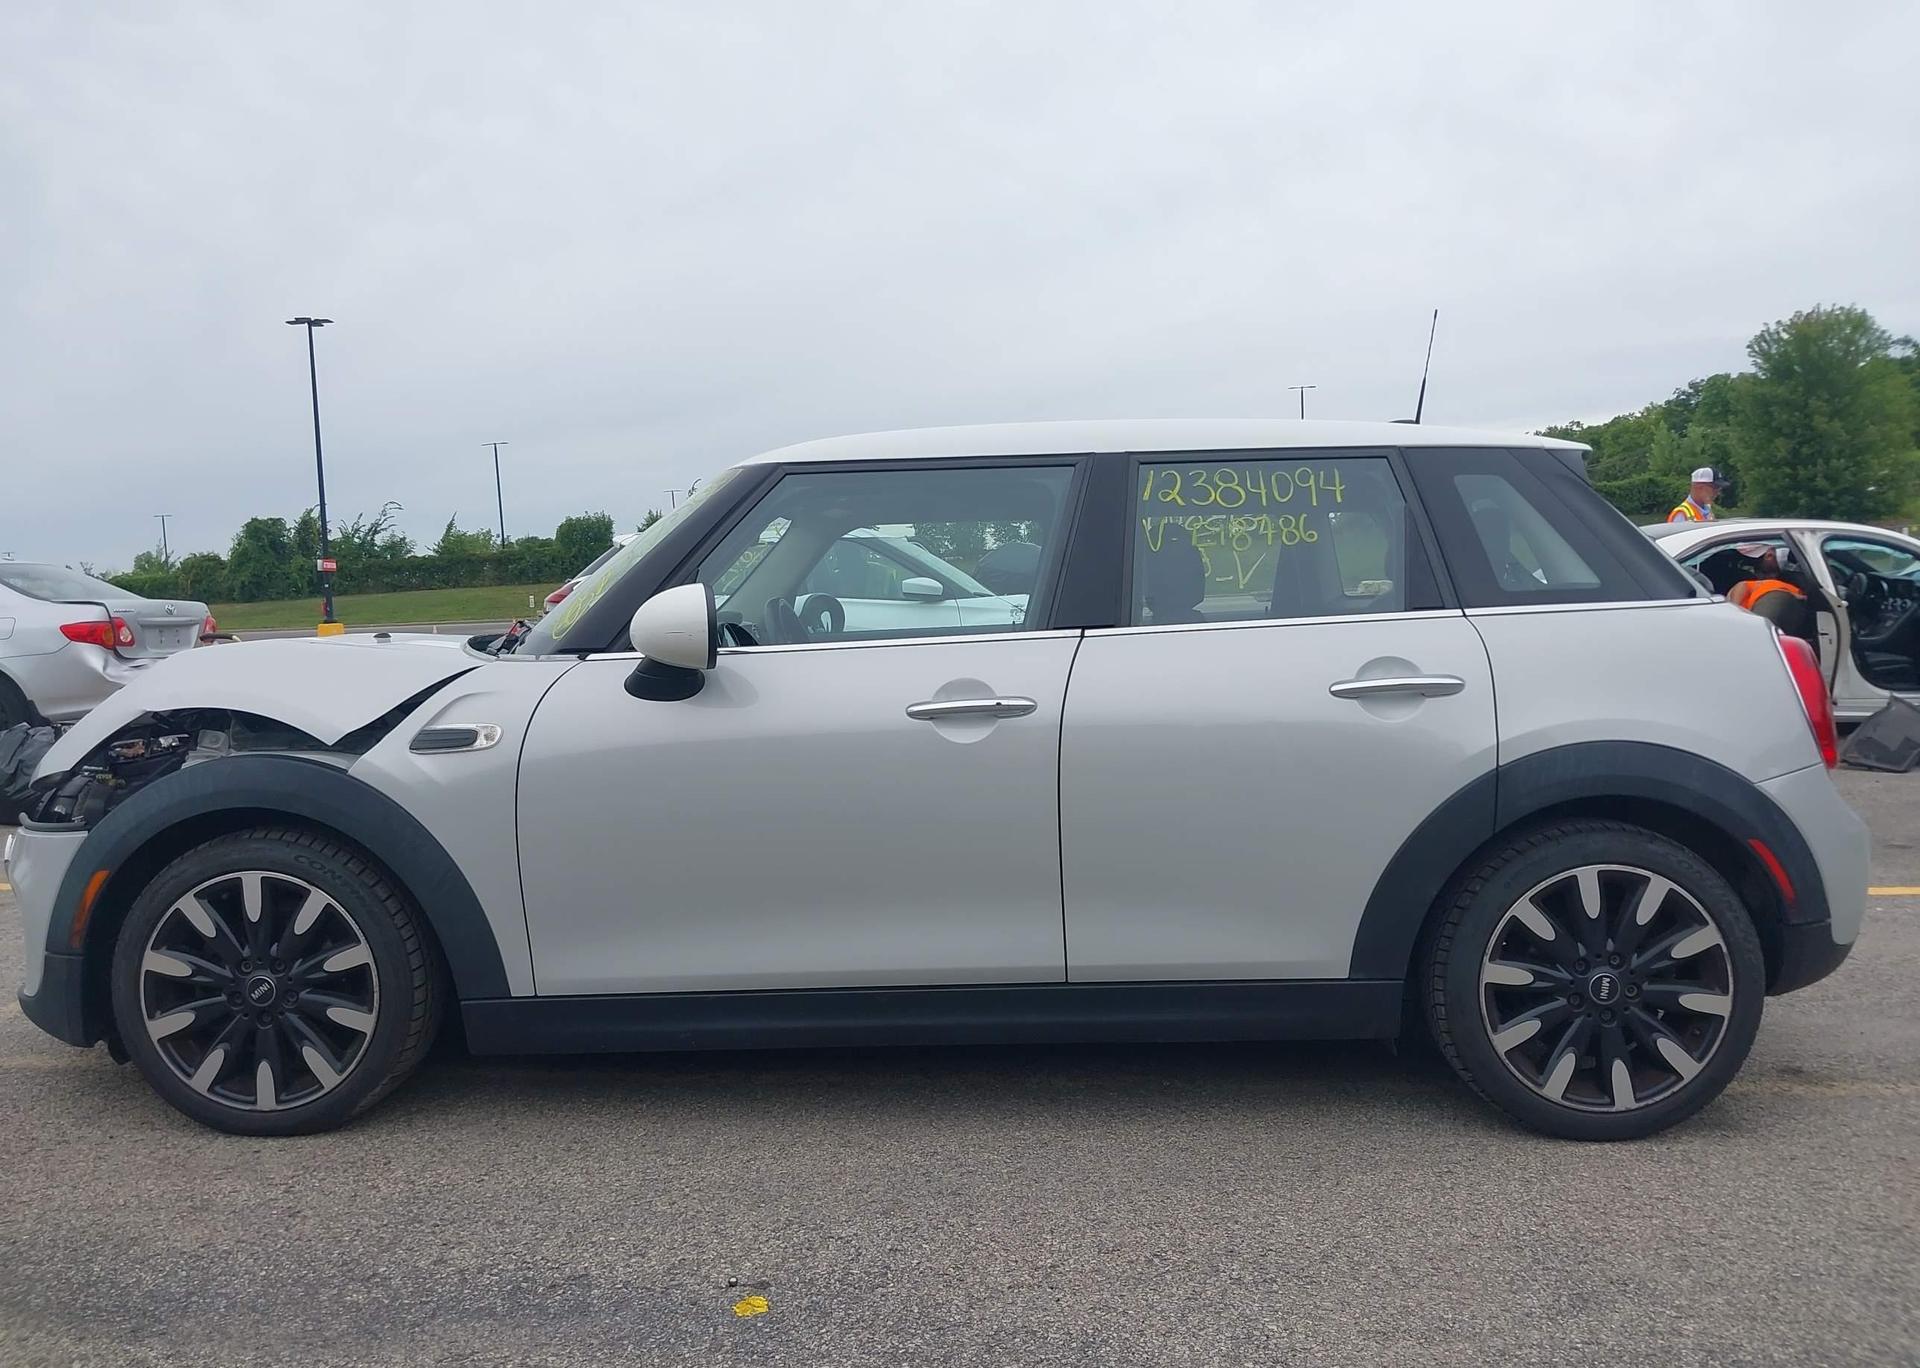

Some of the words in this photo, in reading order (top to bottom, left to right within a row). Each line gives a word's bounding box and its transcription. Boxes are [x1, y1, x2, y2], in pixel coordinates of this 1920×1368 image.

[1143, 467, 1345, 508] 12384094
[251, 982, 270, 1000] MINI
[1600, 977, 1610, 999] MINI
